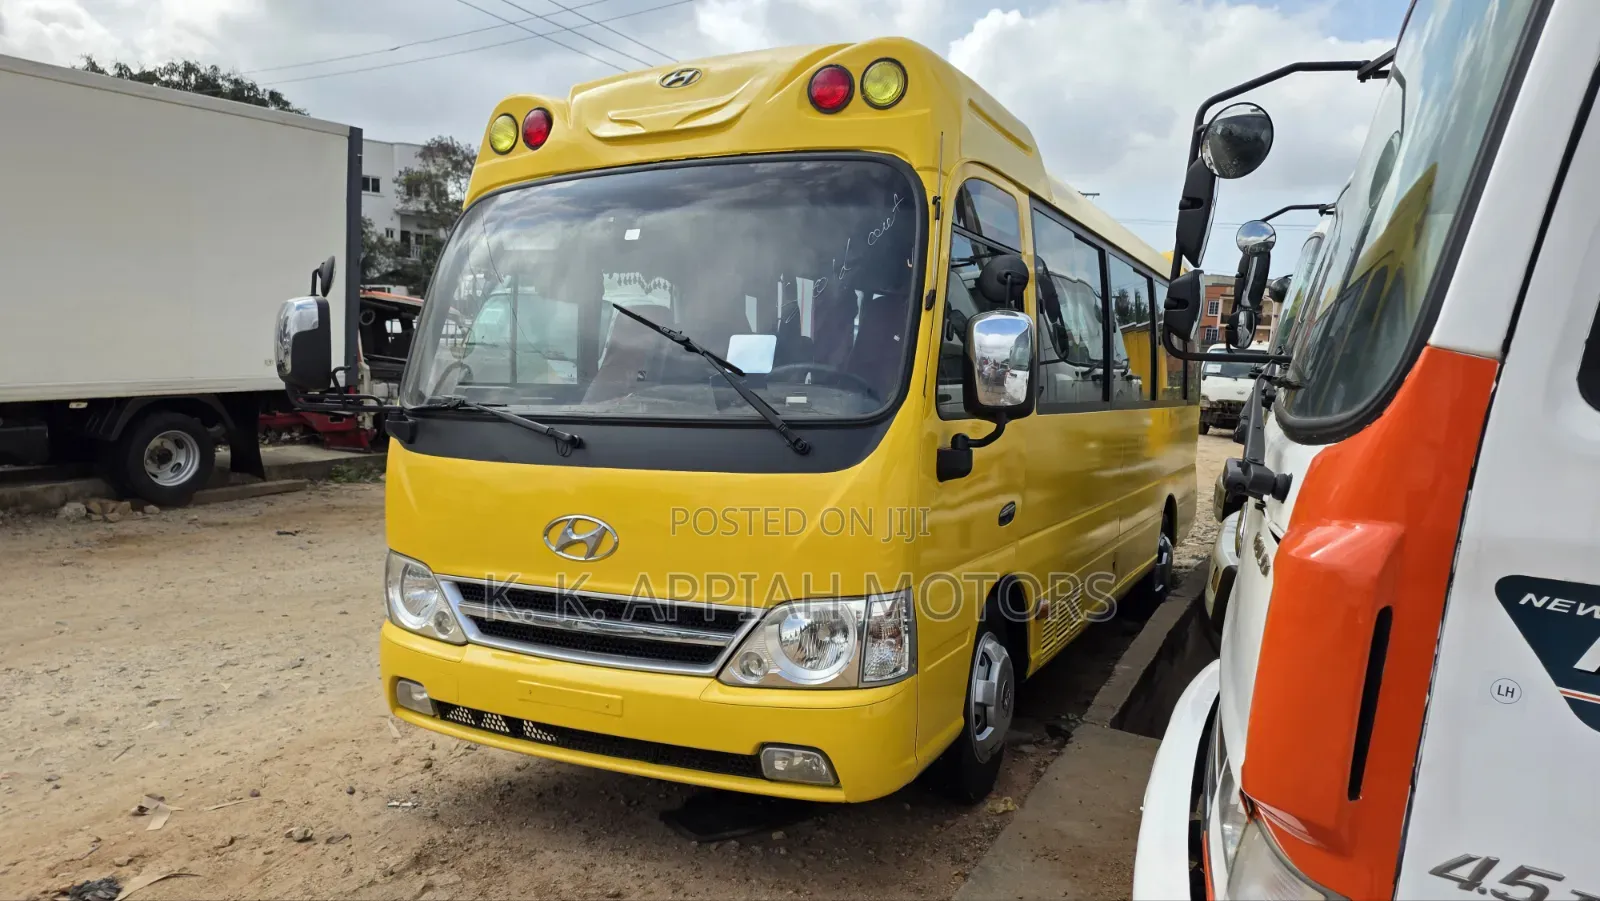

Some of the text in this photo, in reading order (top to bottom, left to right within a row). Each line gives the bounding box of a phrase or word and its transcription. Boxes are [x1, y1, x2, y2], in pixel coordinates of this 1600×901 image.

[1518, 592, 1600, 619] NEW
[1497, 684, 1515, 699] LH
[1429, 853, 1566, 901] 4.5
